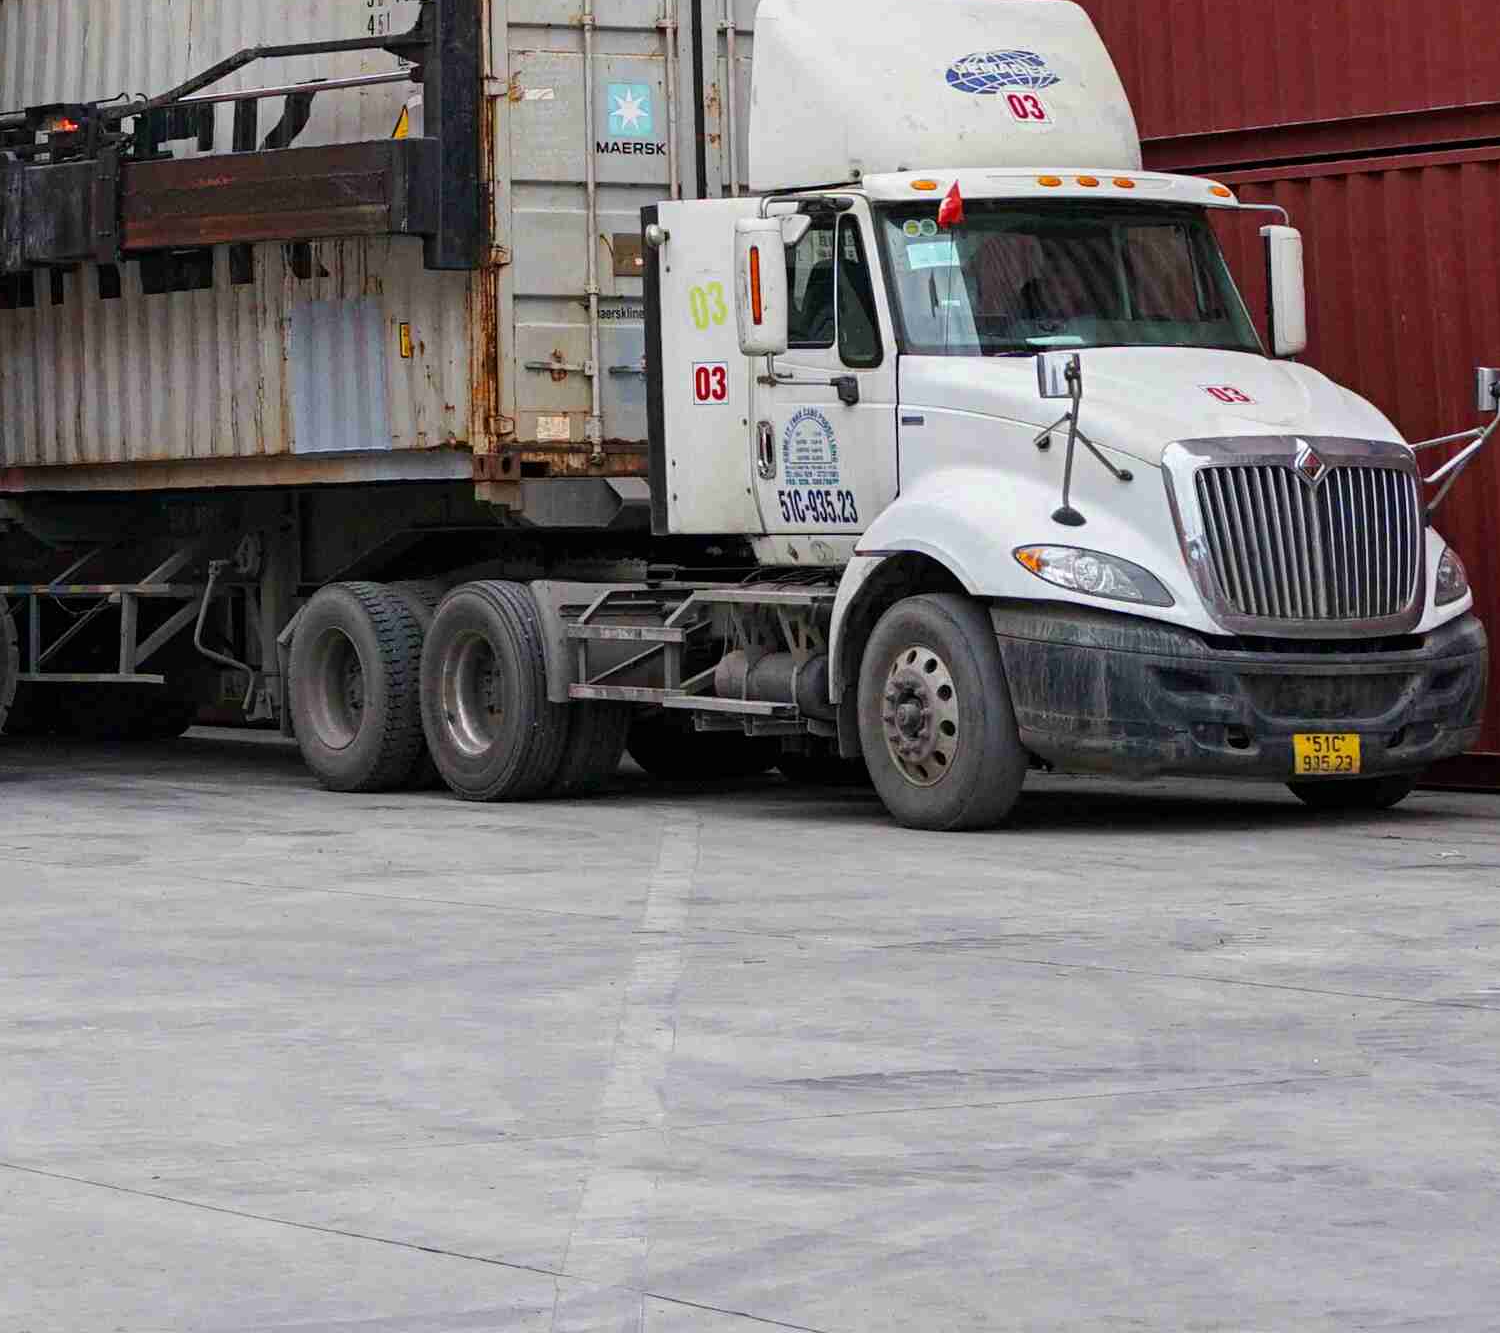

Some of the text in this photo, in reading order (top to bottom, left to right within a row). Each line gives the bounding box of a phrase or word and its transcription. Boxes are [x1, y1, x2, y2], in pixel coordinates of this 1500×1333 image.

[1007, 94, 1045, 120] 03
[596, 141, 666, 156] MAERSK
[597, 307, 645, 320] aerskline
[689, 281, 729, 331] 03
[695, 366, 727, 401] 03
[1207, 387, 1250, 402] 03
[777, 489, 858, 524] 51C-935.23
[1312, 736, 1343, 753] 51C
